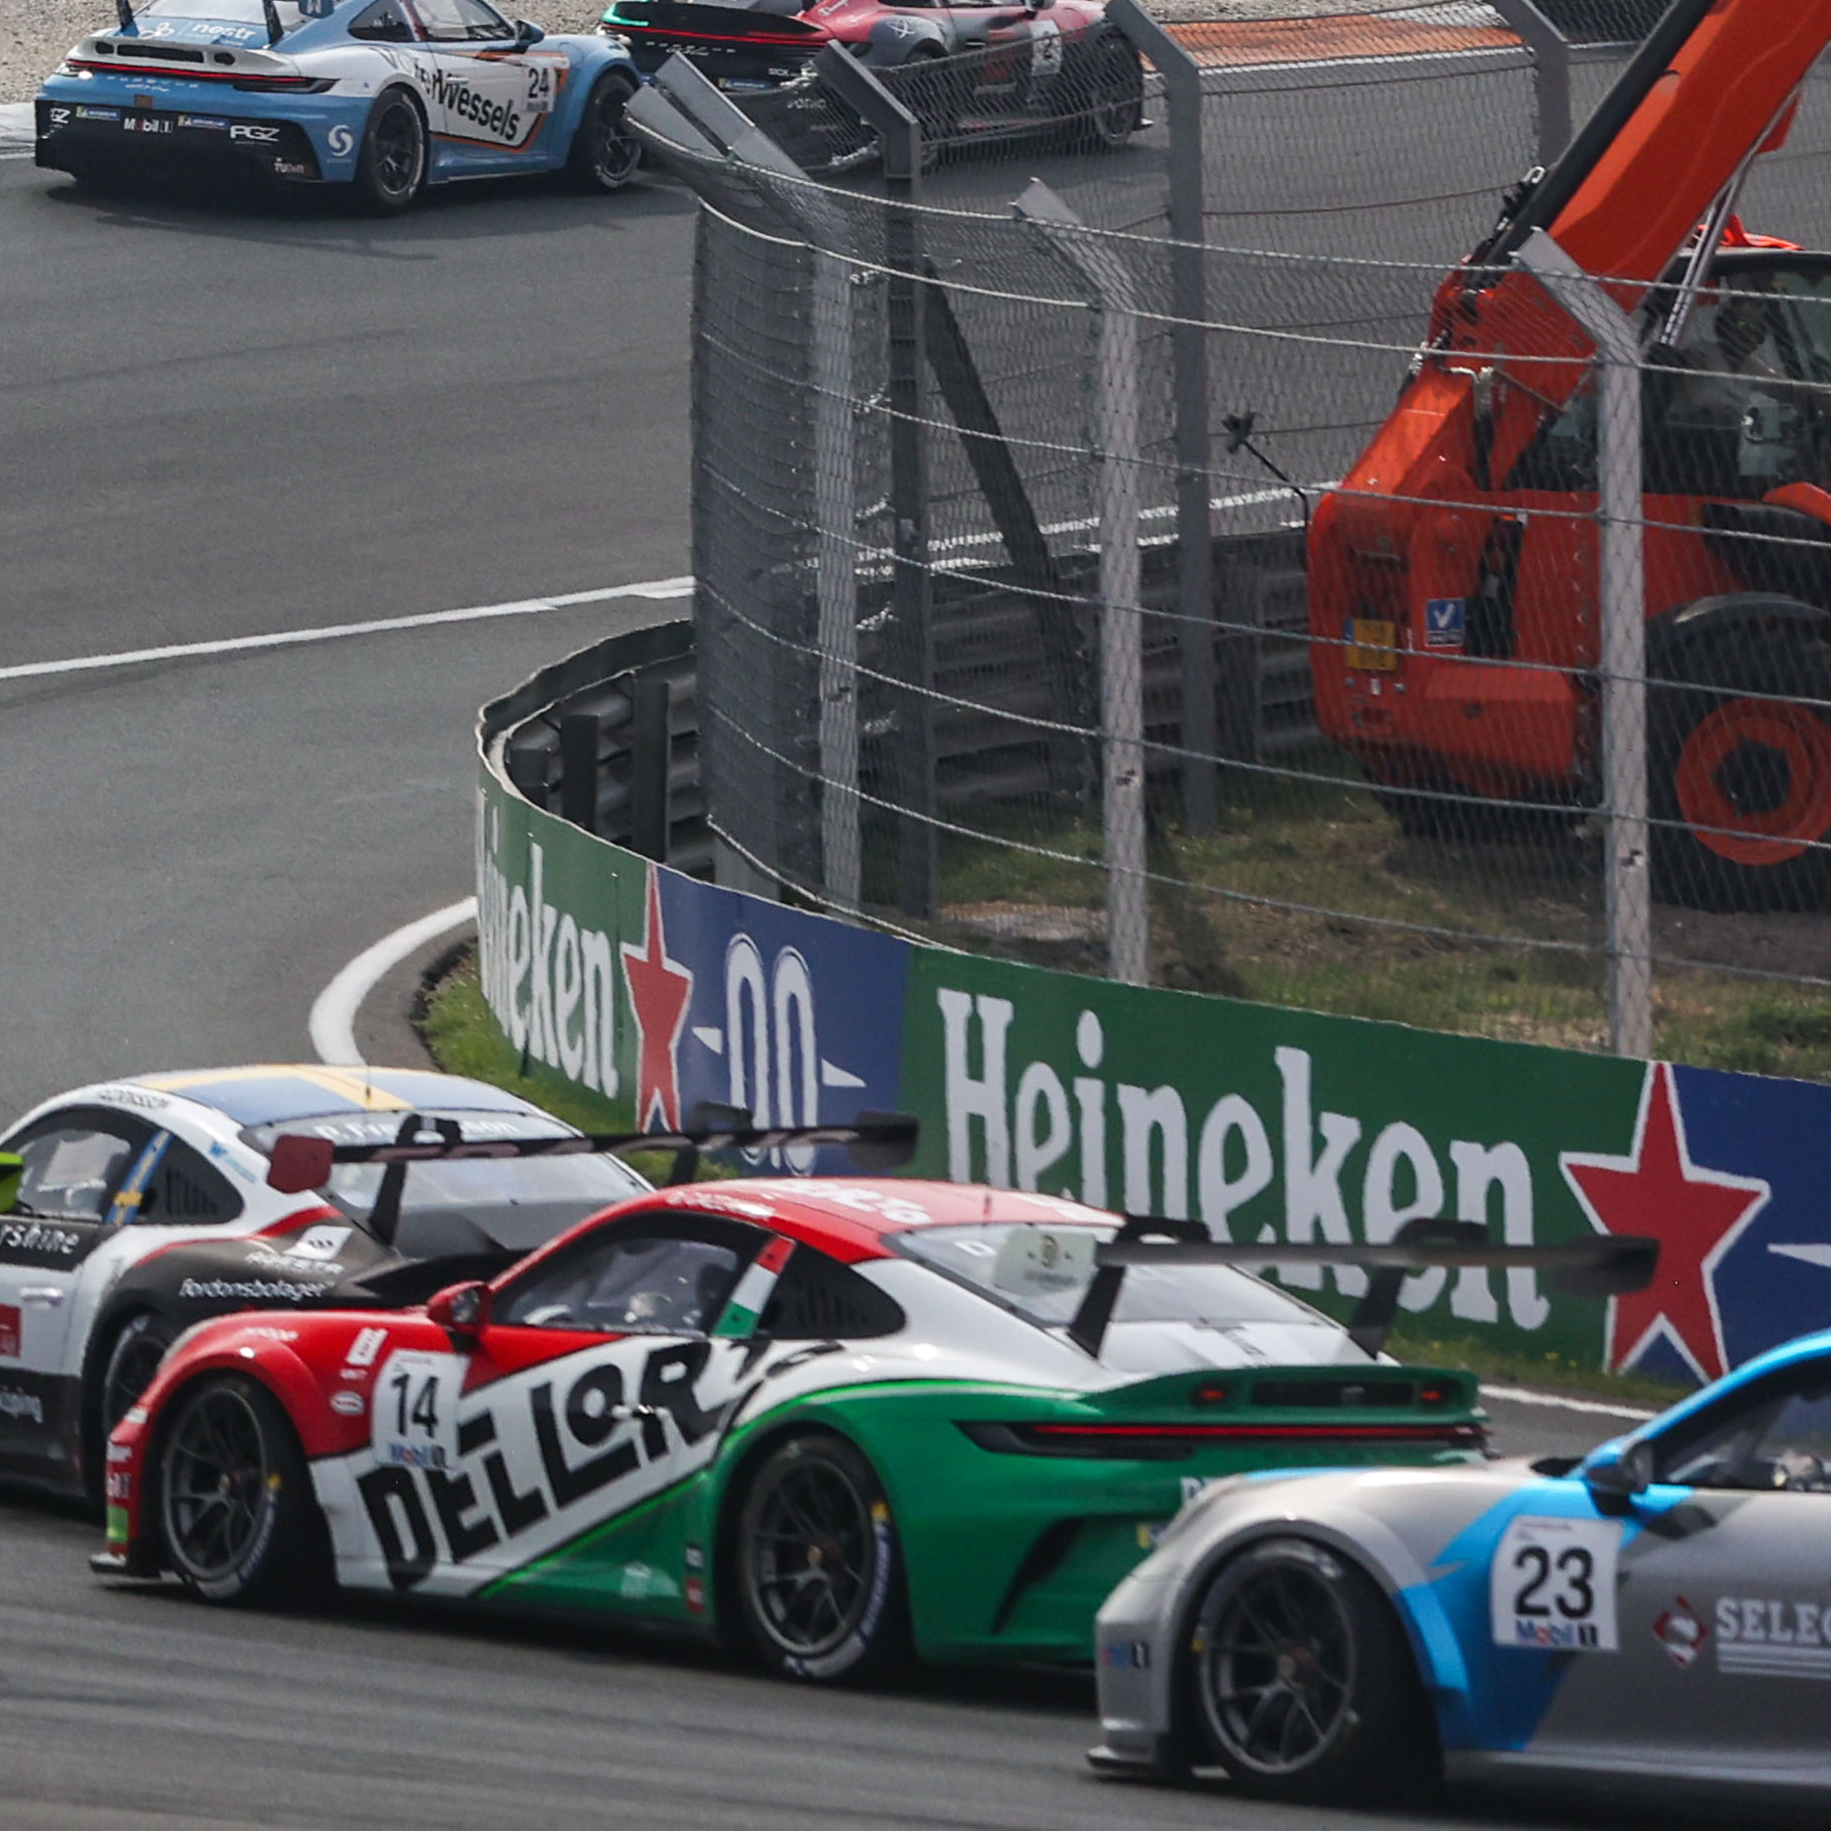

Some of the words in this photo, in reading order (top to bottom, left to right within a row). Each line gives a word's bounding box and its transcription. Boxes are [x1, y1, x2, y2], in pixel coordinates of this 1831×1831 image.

[191, 22, 257, 41] nestr
[527, 67, 550, 99] 24
[229, 125, 281, 142] PGZ
[936, 988, 1549, 1330] Heineken
[390, 1372, 441, 1440] 14
[1513, 1545, 1595, 1619] 23
